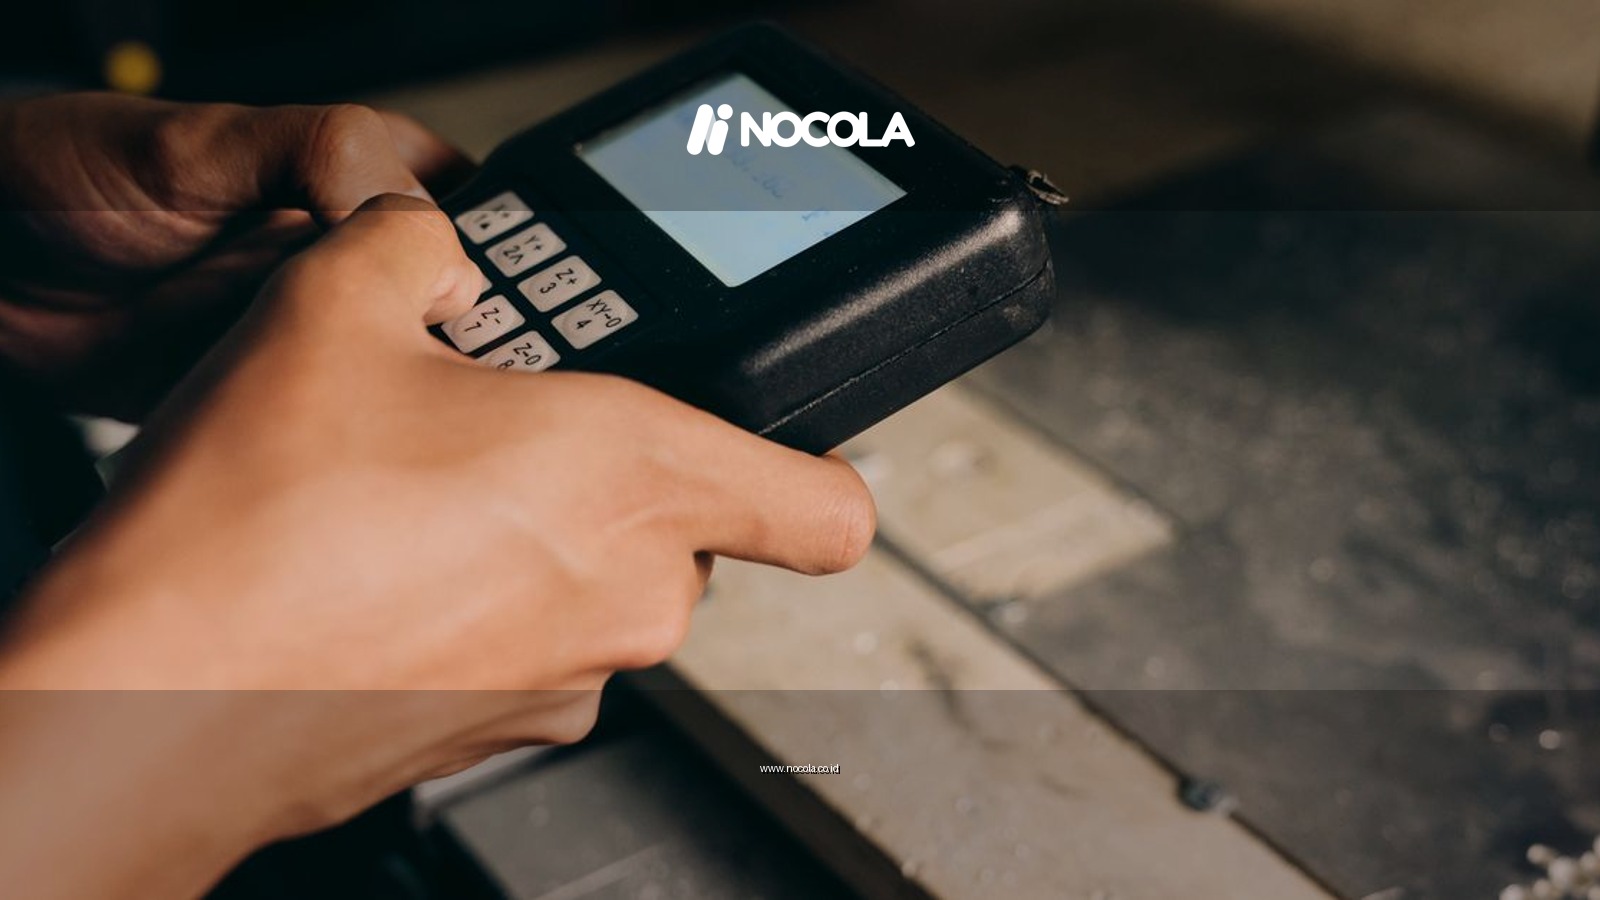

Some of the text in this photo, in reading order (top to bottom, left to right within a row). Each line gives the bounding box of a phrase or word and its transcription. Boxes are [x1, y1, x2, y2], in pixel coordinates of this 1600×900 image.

[524, 235, 543, 251] Y+
[556, 268, 578, 286] Z+
[540, 282, 556, 294] 3
[481, 307, 501, 324] Z-
[464, 321, 481, 333] 7
[576, 319, 592, 330] 4
